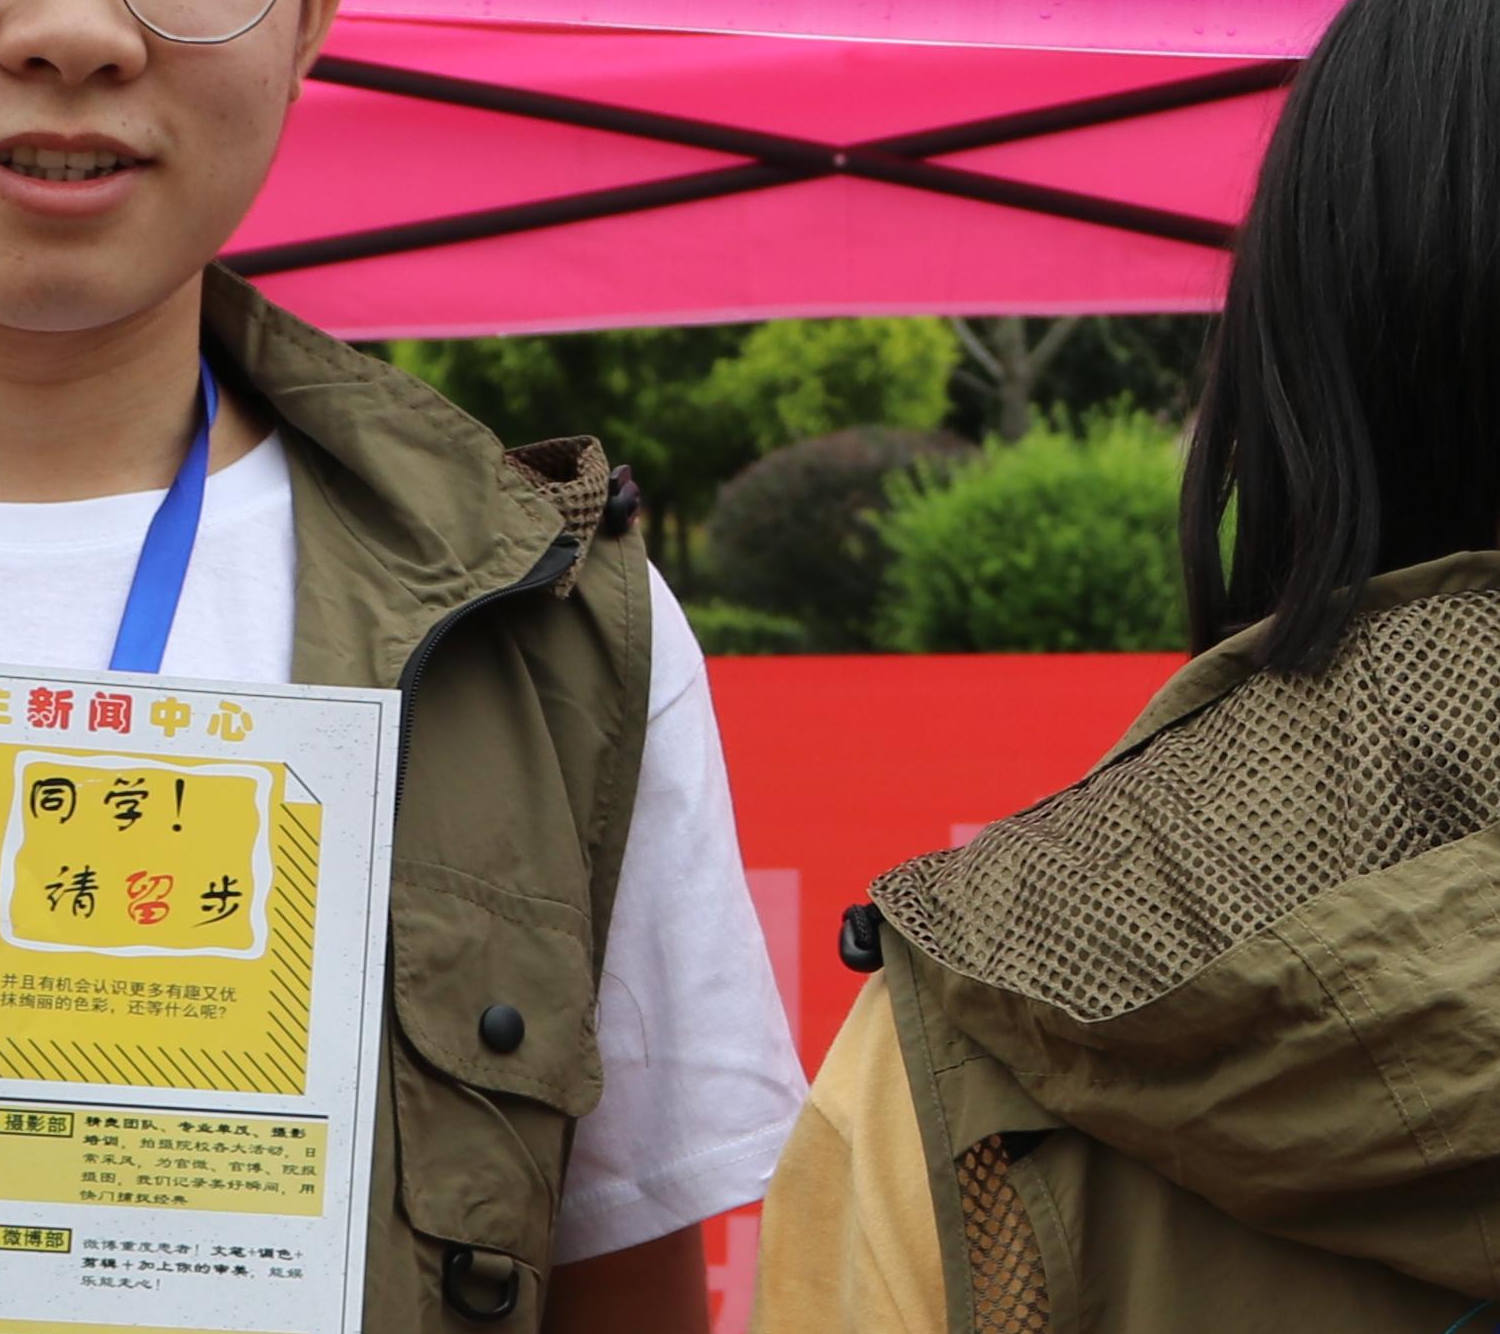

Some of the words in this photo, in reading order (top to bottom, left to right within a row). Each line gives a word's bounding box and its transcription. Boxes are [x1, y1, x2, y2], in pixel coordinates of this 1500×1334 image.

[44, 864, 244, 929] 请留步
[4, 1113, 67, 1134] 摄影部
[2, 1228, 66, 1249] 微博部
